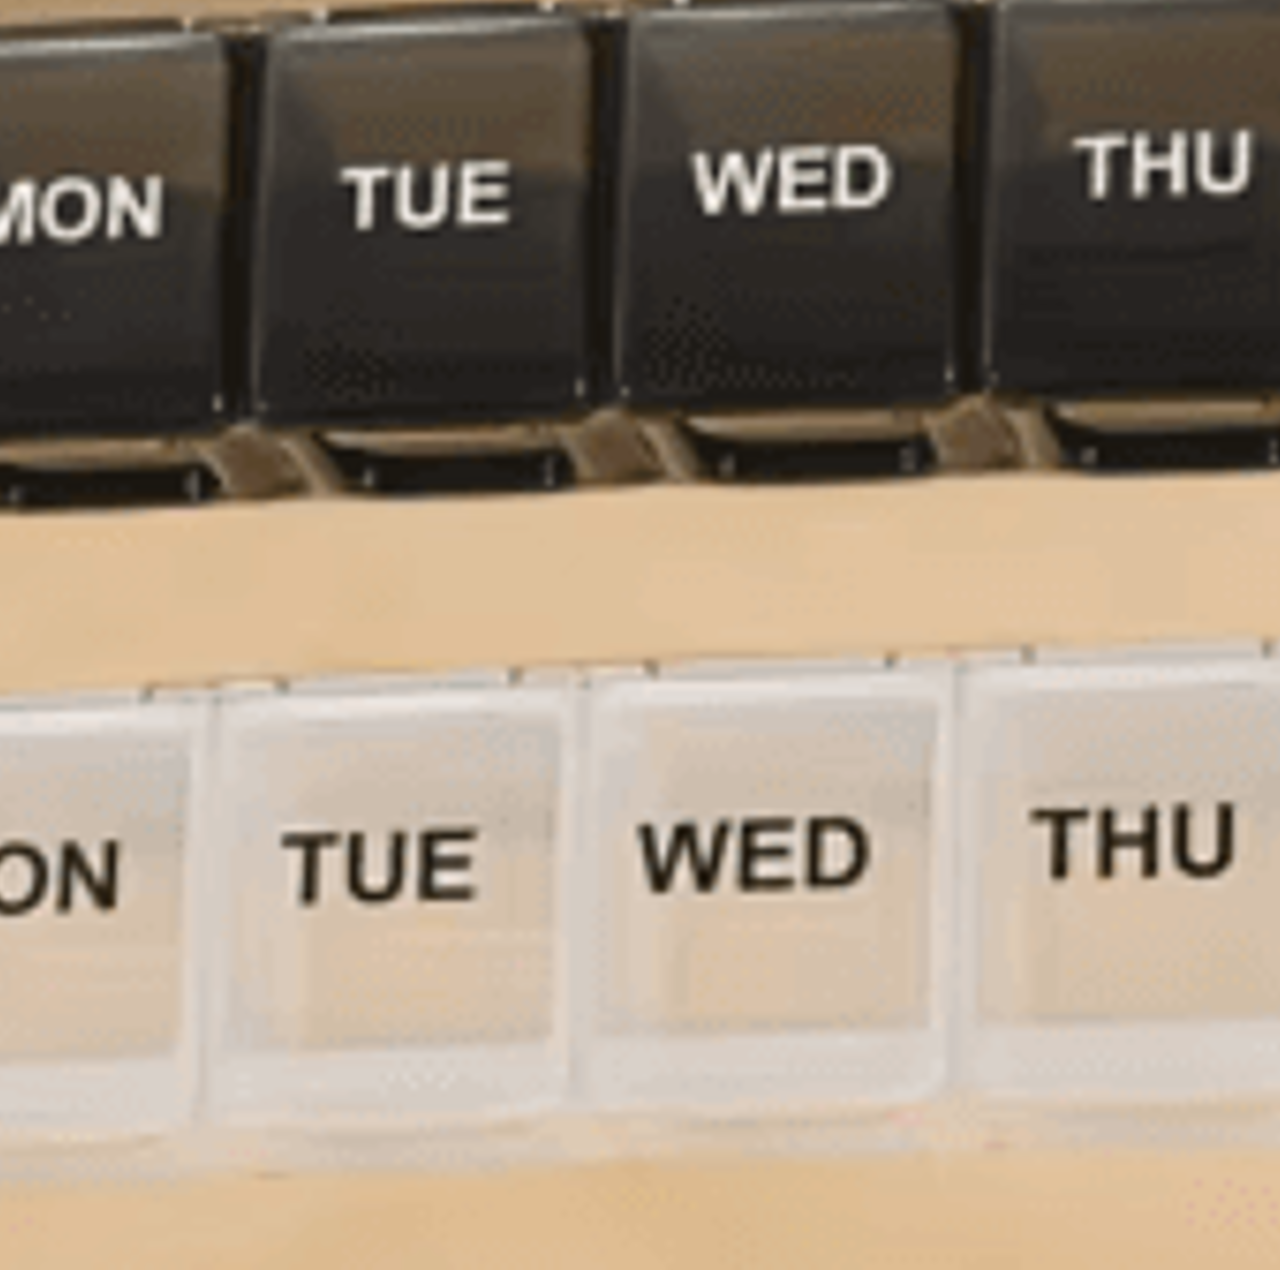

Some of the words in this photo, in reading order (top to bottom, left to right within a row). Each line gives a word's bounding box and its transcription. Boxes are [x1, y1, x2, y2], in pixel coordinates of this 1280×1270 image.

[340, 159, 510, 230] TUE
[692, 144, 891, 215] WED
[1073, 128, 1252, 199] THU
[281, 826, 478, 907] TUE
[637, 814, 872, 896] WED
[1030, 800, 1236, 882] THU
